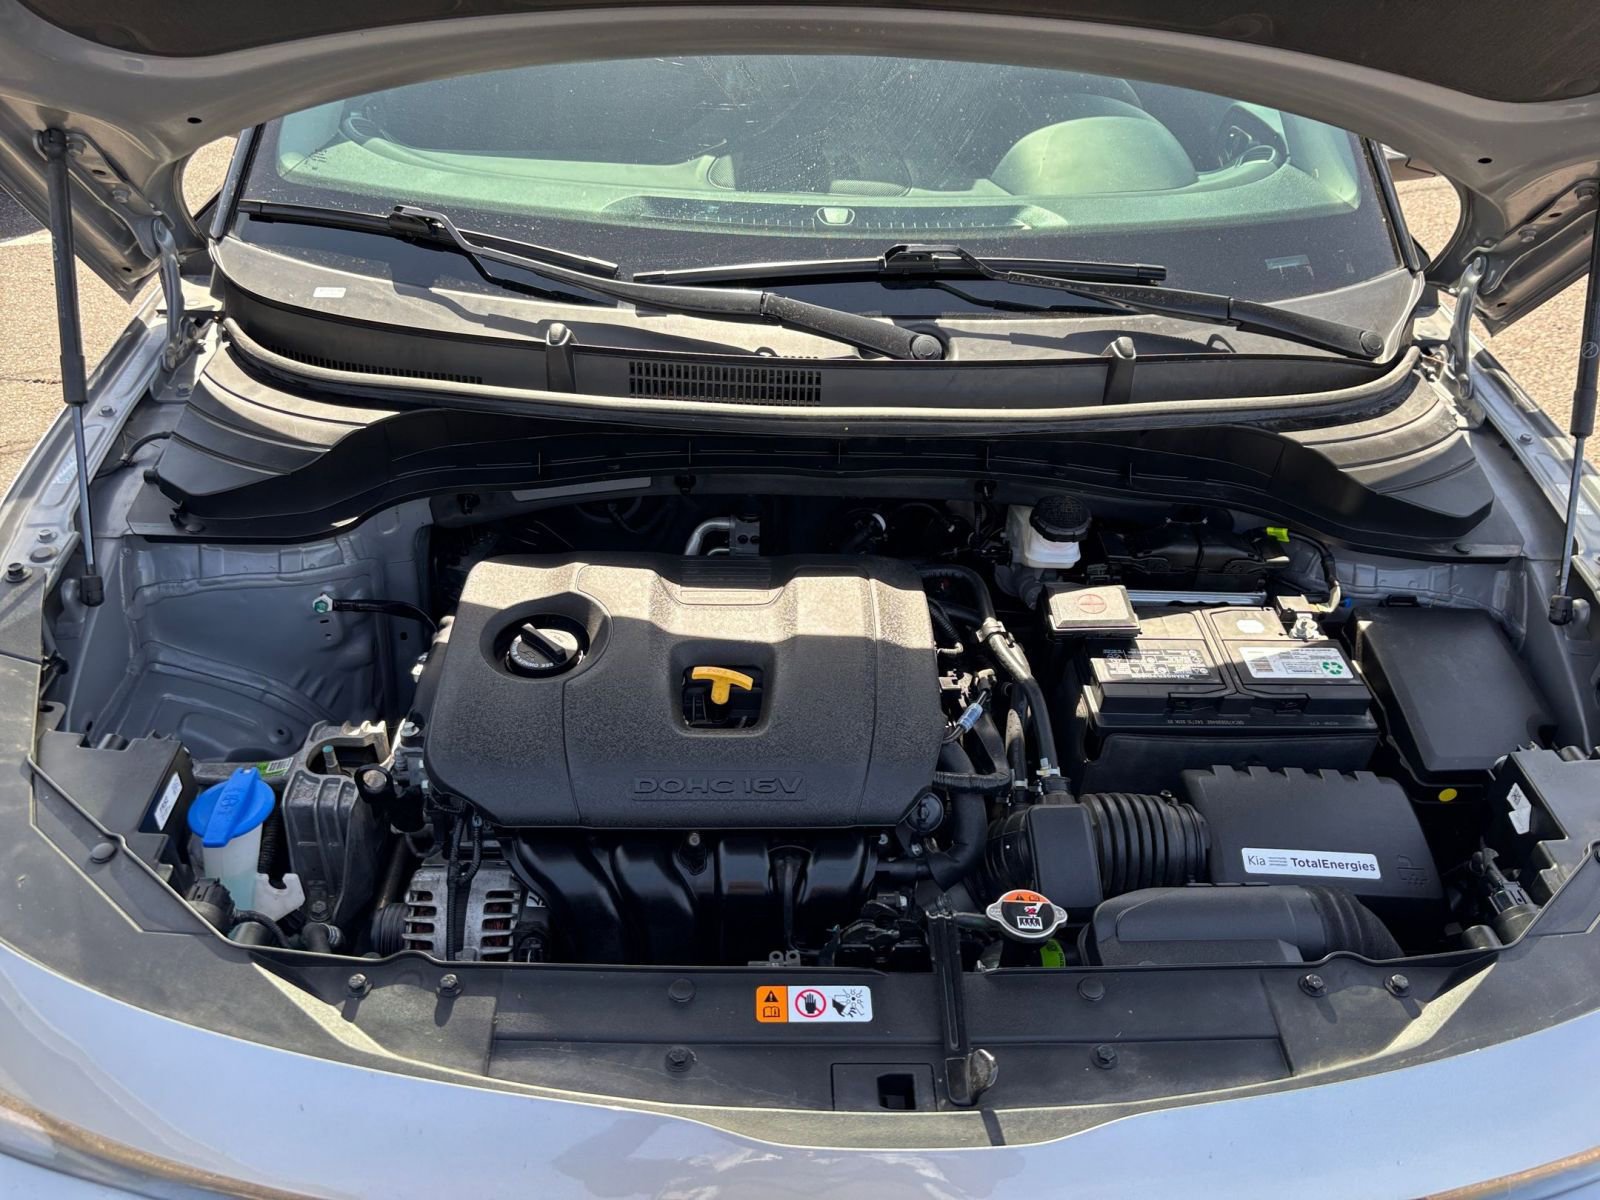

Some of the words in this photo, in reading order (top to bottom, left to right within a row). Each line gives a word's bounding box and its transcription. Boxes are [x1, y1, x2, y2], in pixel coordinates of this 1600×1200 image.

[633, 777, 735, 794] DOHC
[744, 777, 804, 794] 16V
[1248, 855, 1266, 867] Kia
[1290, 857, 1376, 873] TotalEnergies
